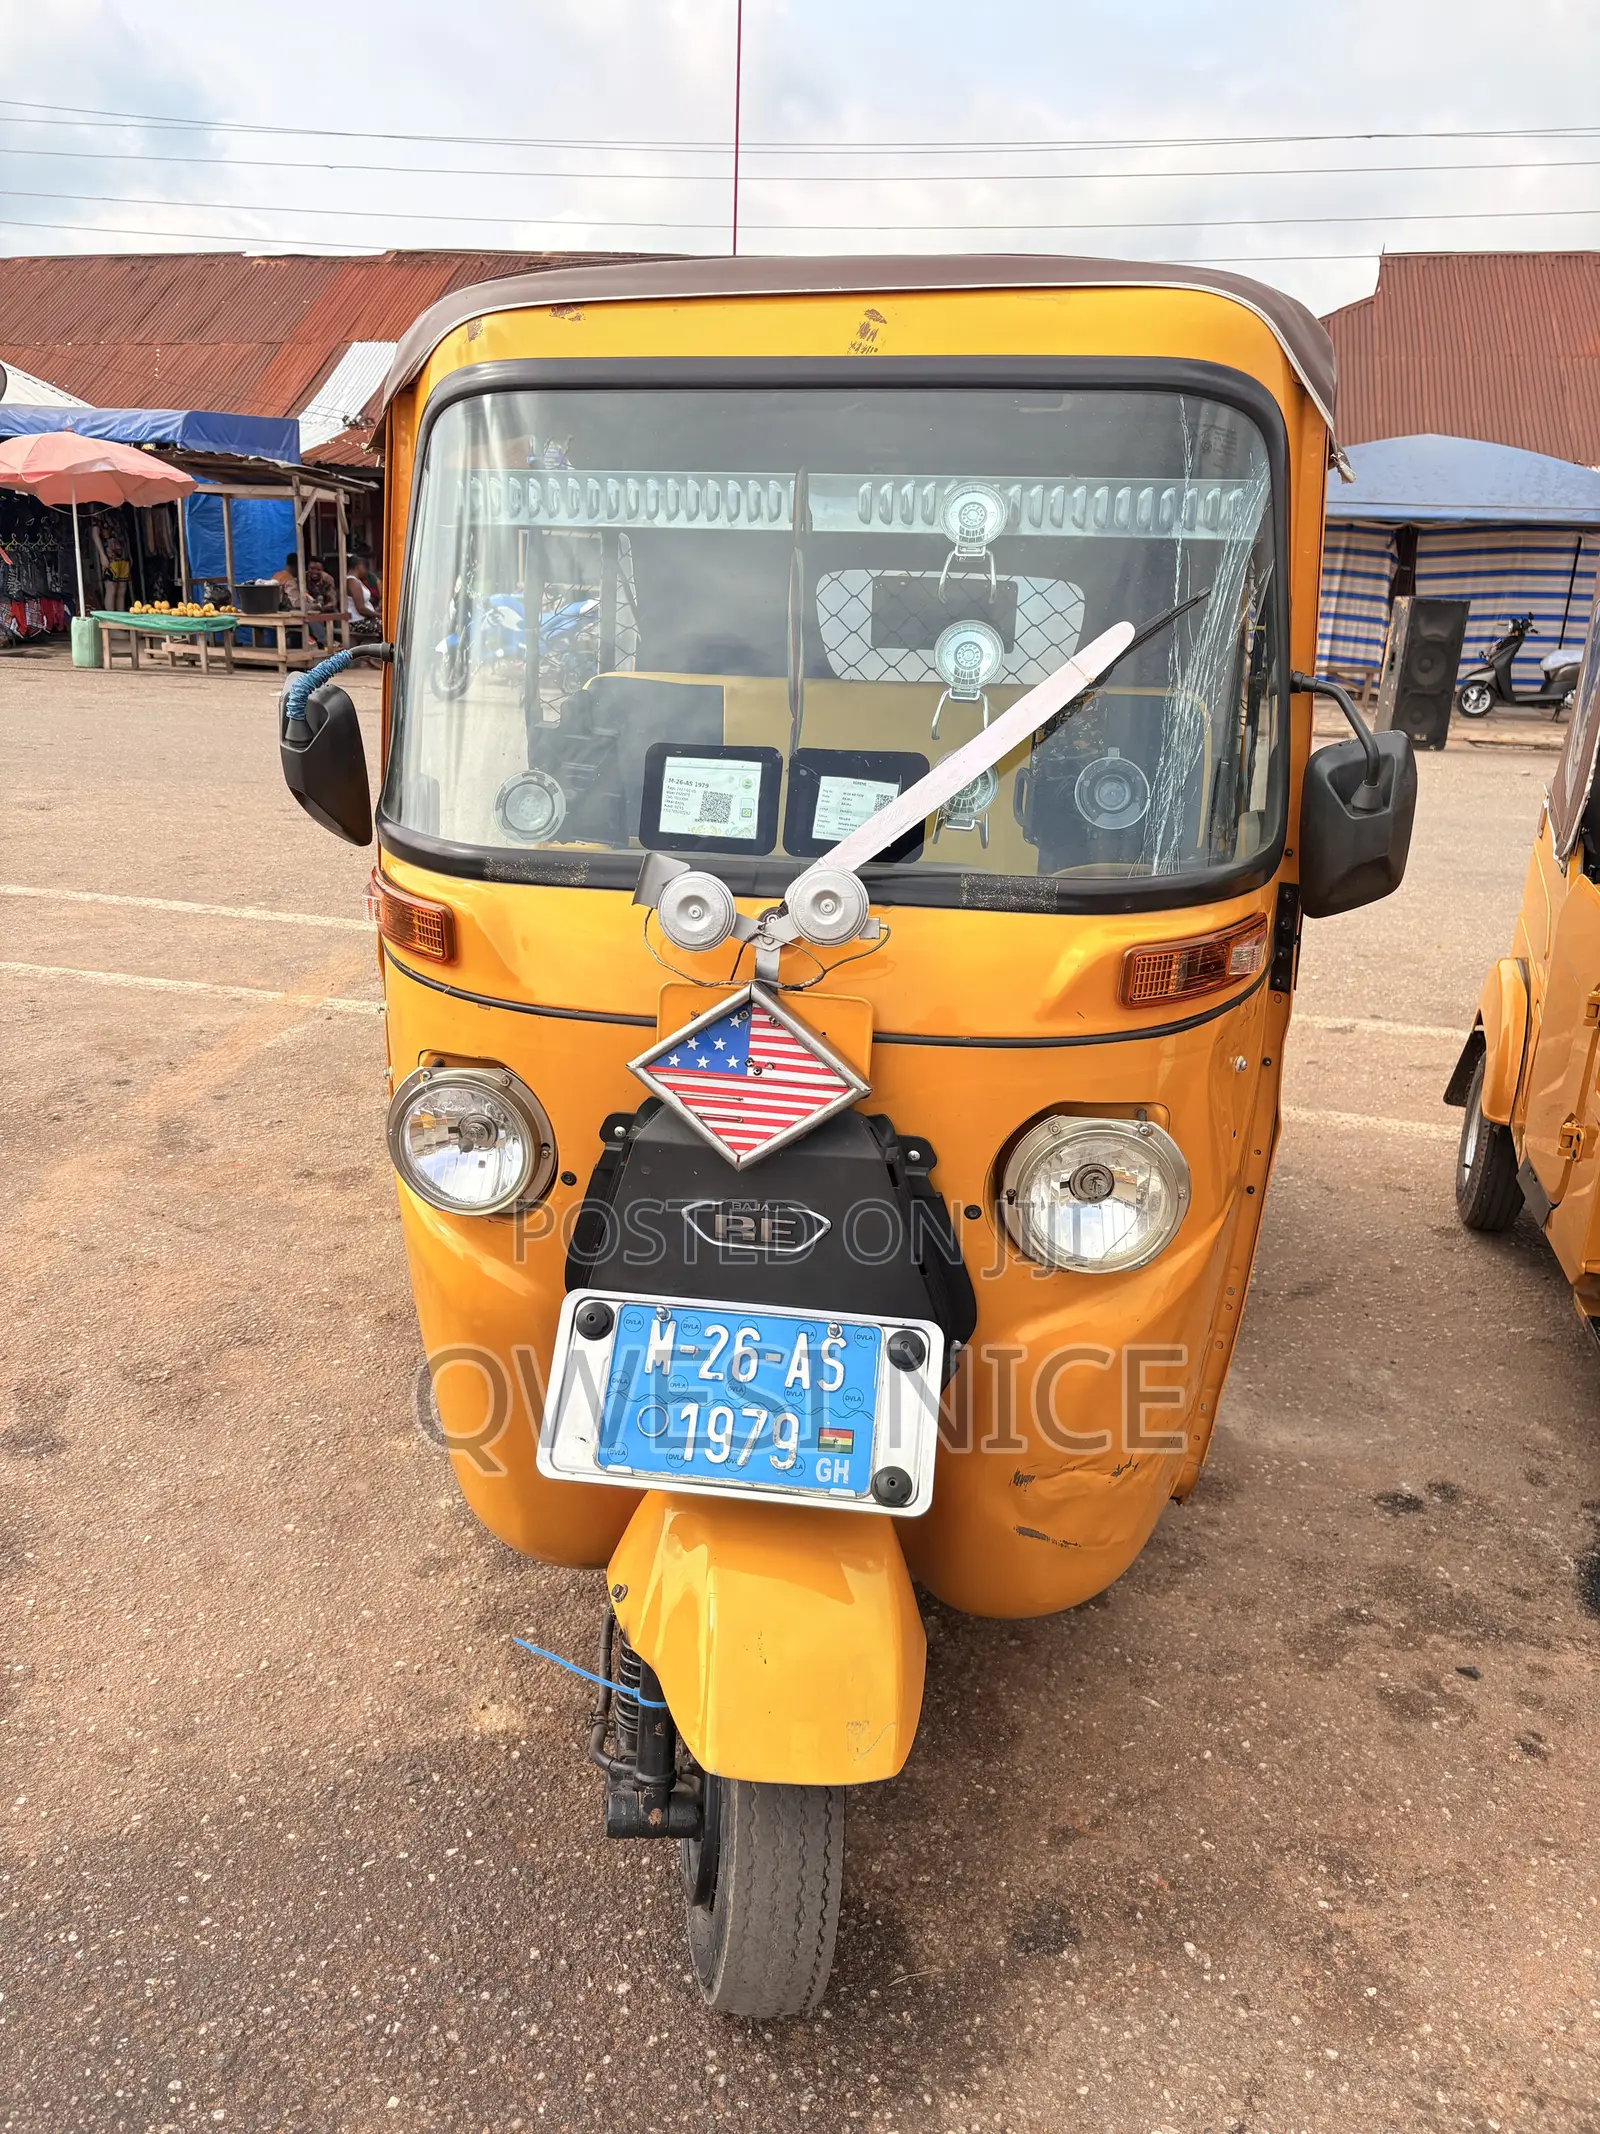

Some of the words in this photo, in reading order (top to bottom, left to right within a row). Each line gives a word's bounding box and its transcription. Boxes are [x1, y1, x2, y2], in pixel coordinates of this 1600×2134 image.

[731, 1201, 780, 1213] BAJAJ
[714, 1214, 796, 1245] RE
[625, 1318, 642, 1326] DVLA
[682, 1323, 700, 1331] DVLA
[644, 1319, 848, 1392] M-26-AS
[611, 1377, 628, 1385] DVLA
[844, 1395, 862, 1403] DVLA
[680, 1403, 799, 1470] 1979
[815, 1457, 850, 1484] GH
